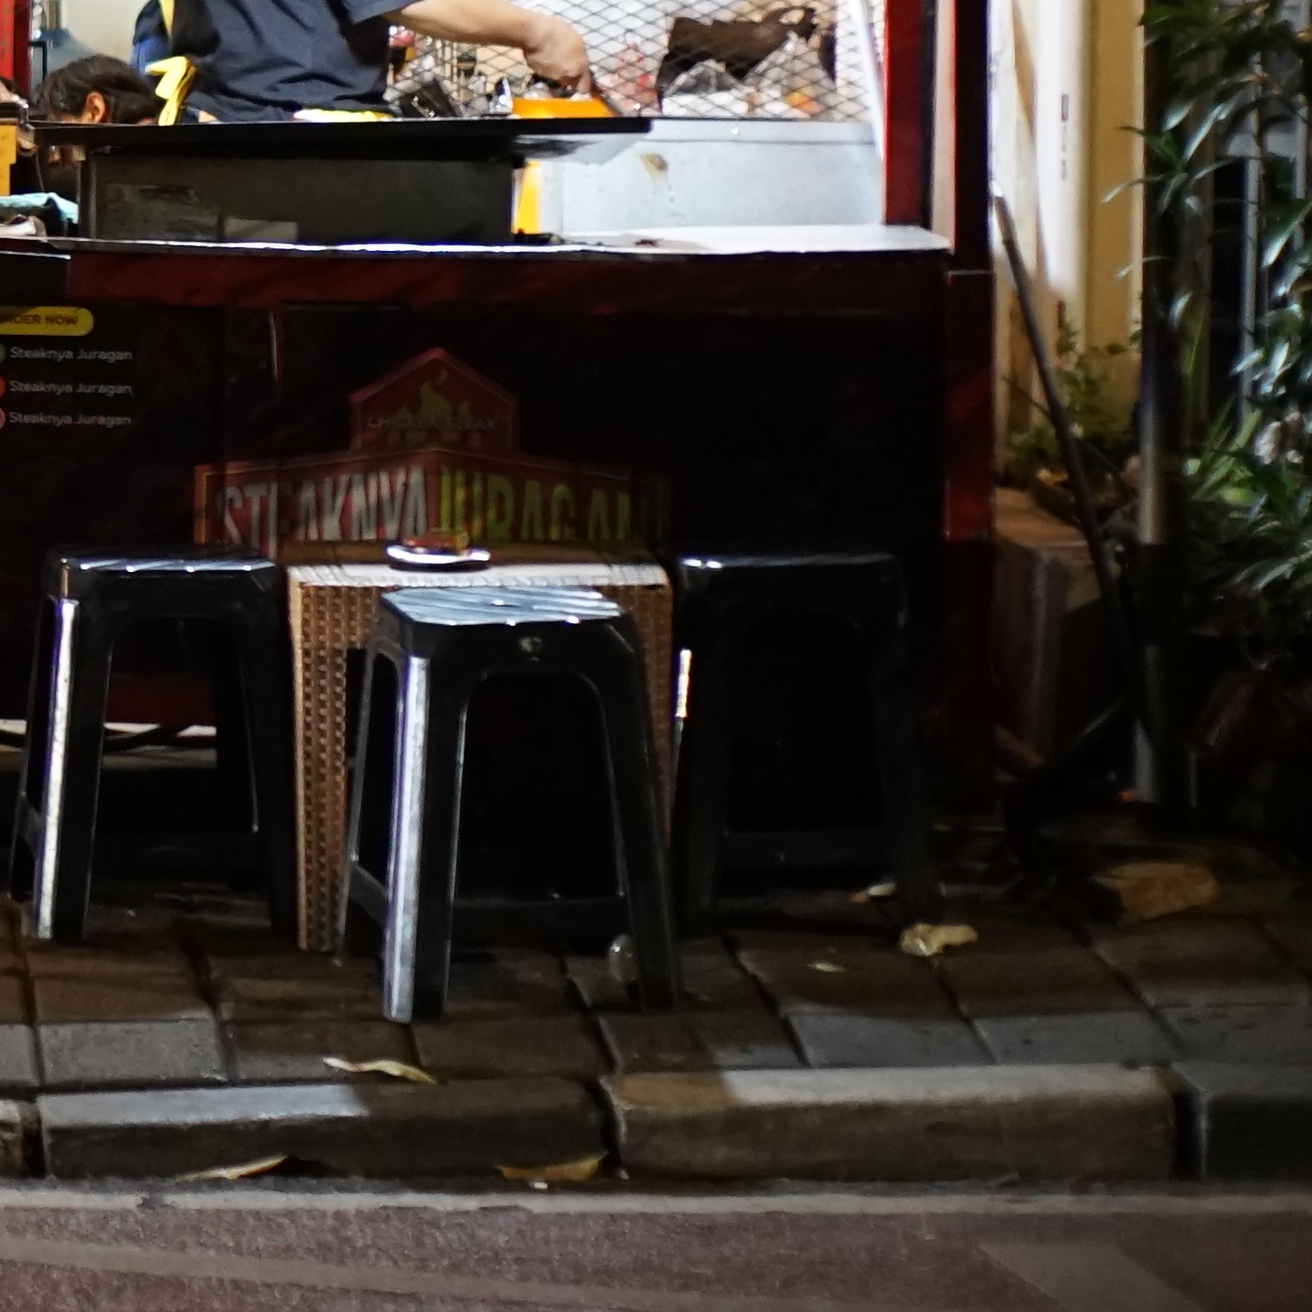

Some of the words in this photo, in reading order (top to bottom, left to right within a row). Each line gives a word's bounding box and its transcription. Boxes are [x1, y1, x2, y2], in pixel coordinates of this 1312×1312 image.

[9, 346, 74, 363] Steaknya
[75, 347, 133, 364] Juragan
[8, 379, 74, 396] Steaknya
[75, 381, 133, 398] Juragan
[9, 411, 73, 427] Steaknya
